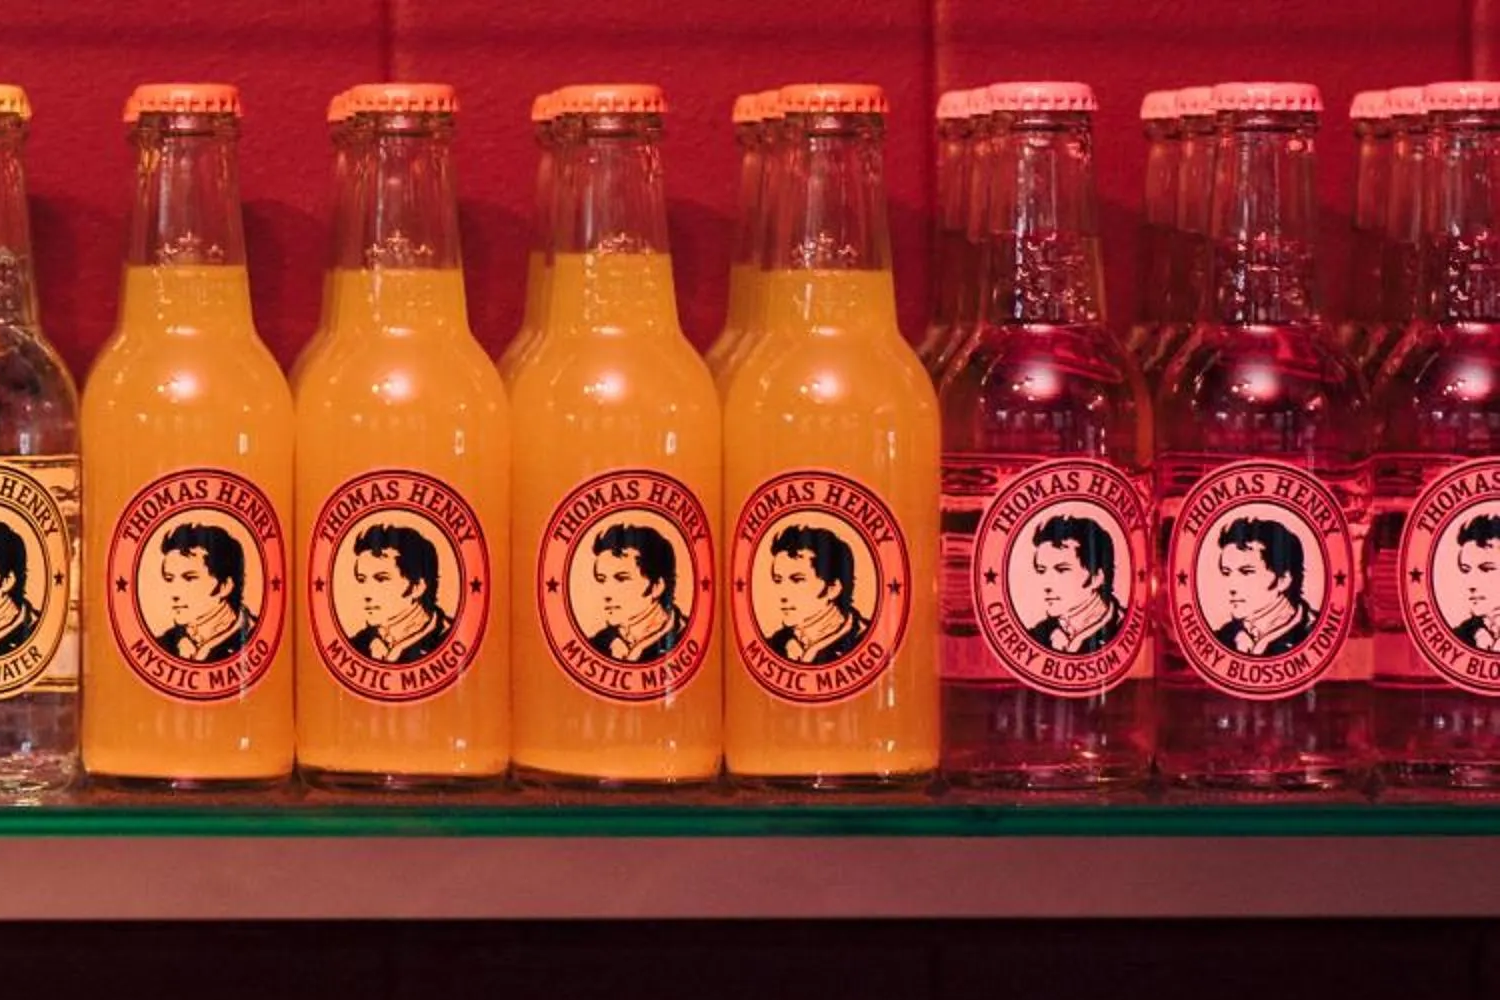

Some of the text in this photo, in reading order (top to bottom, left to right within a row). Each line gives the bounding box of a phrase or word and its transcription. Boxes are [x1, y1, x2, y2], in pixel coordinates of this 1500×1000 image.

[122, 480, 278, 545] THOMAS HENRY
[318, 480, 478, 545] THOMAS HENRY
[553, 480, 707, 545] THOMAS HENRY
[740, 481, 896, 546] THOMAS HENRY
[991, 471, 1145, 536] THOMAS HENRY
[1182, 474, 1341, 537] THOMAS HENRY
[130, 639, 270, 690] MYSTIC MANGO
[327, 640, 466, 691] MYSTIC MANGO
[562, 639, 701, 691] MYSTIC MANGO
[745, 640, 885, 692] MYSTIC MANGO
[987, 601, 1145, 681] CHERRY BLOSSOM TONIC
[1179, 603, 1345, 684] CHERRY BLOSSOM TONIC
[1412, 601, 1465, 667] CHERRY
